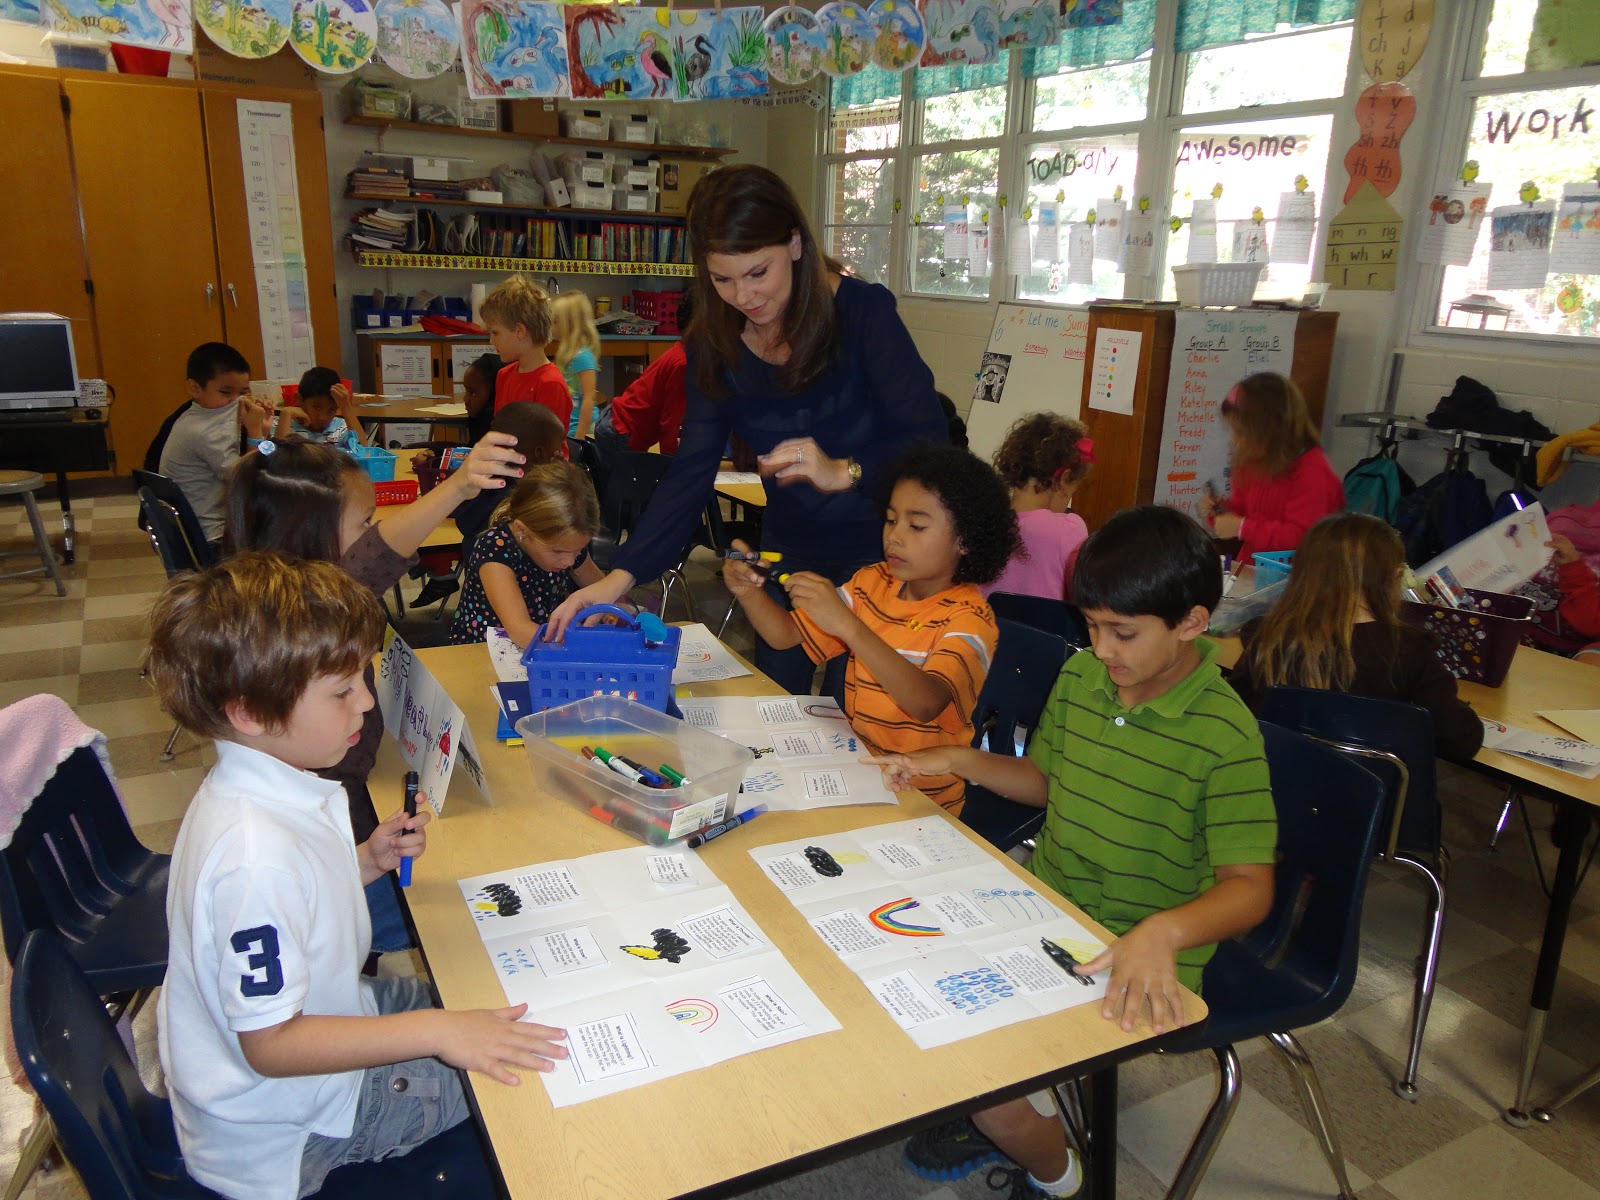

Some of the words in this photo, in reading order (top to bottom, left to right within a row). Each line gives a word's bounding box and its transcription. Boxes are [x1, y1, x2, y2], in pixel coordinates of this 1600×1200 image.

[1486, 97, 1596, 144] Work
[1330, 229, 1343, 239] m
[1357, 227, 1367, 237] n
[1381, 227, 1397, 240] ng
[1350, 246, 1368, 261] wh
[1028, 312, 1042, 326] Let
[1045, 317, 1059, 328] me
[1190, 335, 1213, 349] Group
[1218, 336, 1227, 348] A
[1246, 336, 1269, 349] Group
[1272, 336, 1280, 348] B
[1187, 352, 1220, 363] Charlie
[1184, 381, 1206, 396] Riley
[1177, 411, 1216, 423] Michelle
[1179, 425, 1207, 440] Freddy
[1173, 456, 1197, 467] Kiran
[1170, 485, 1201, 496] Hunter
[230, 924, 284, 997] 3
[764, 994, 774, 1002] What
[775, 1005, 787, 1016] Rain?
[615, 1025, 623, 1035] What
[620, 1039, 634, 1060] Lightning?
